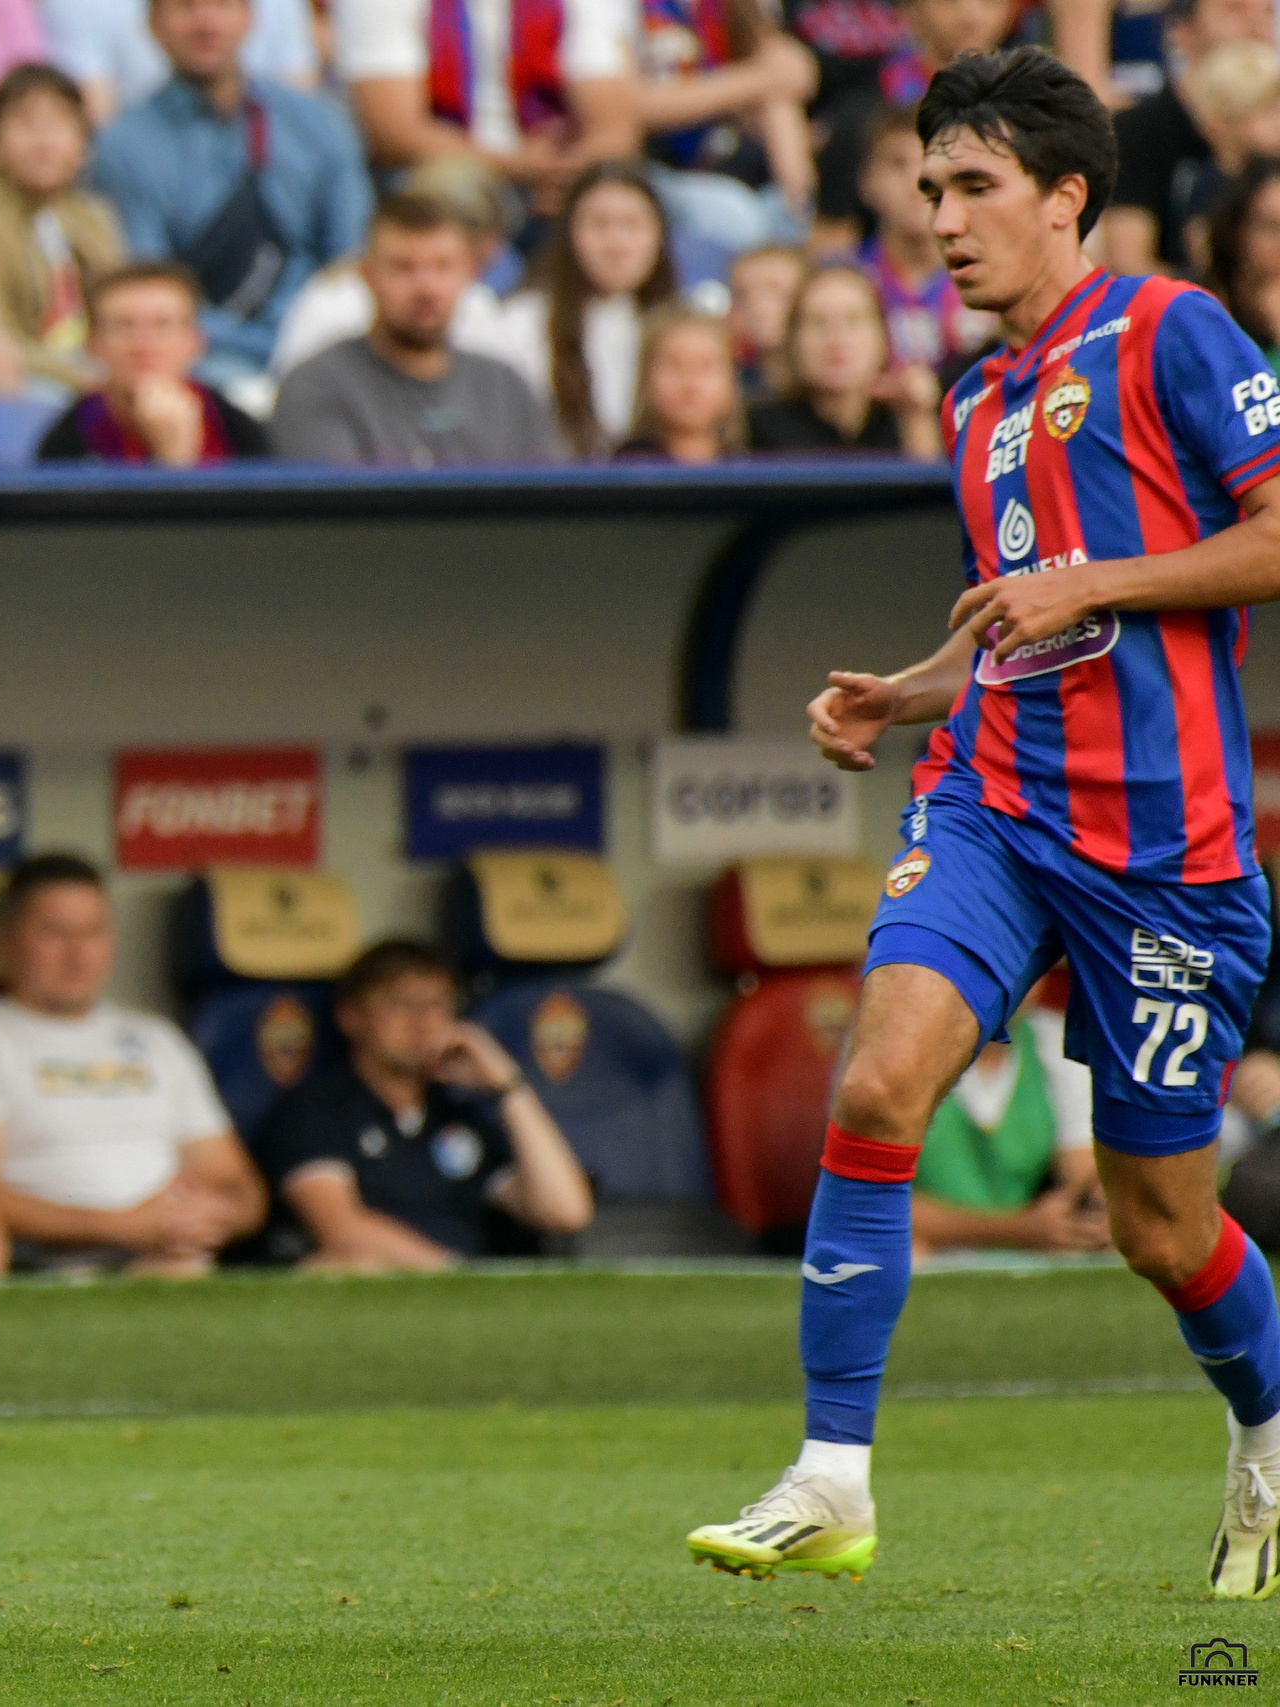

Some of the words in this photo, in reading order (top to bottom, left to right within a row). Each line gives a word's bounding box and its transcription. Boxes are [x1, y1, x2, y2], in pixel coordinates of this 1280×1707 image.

[987, 400, 1037, 452] FON
[984, 430, 1034, 483] BET
[1131, 997, 1209, 1087] 72
